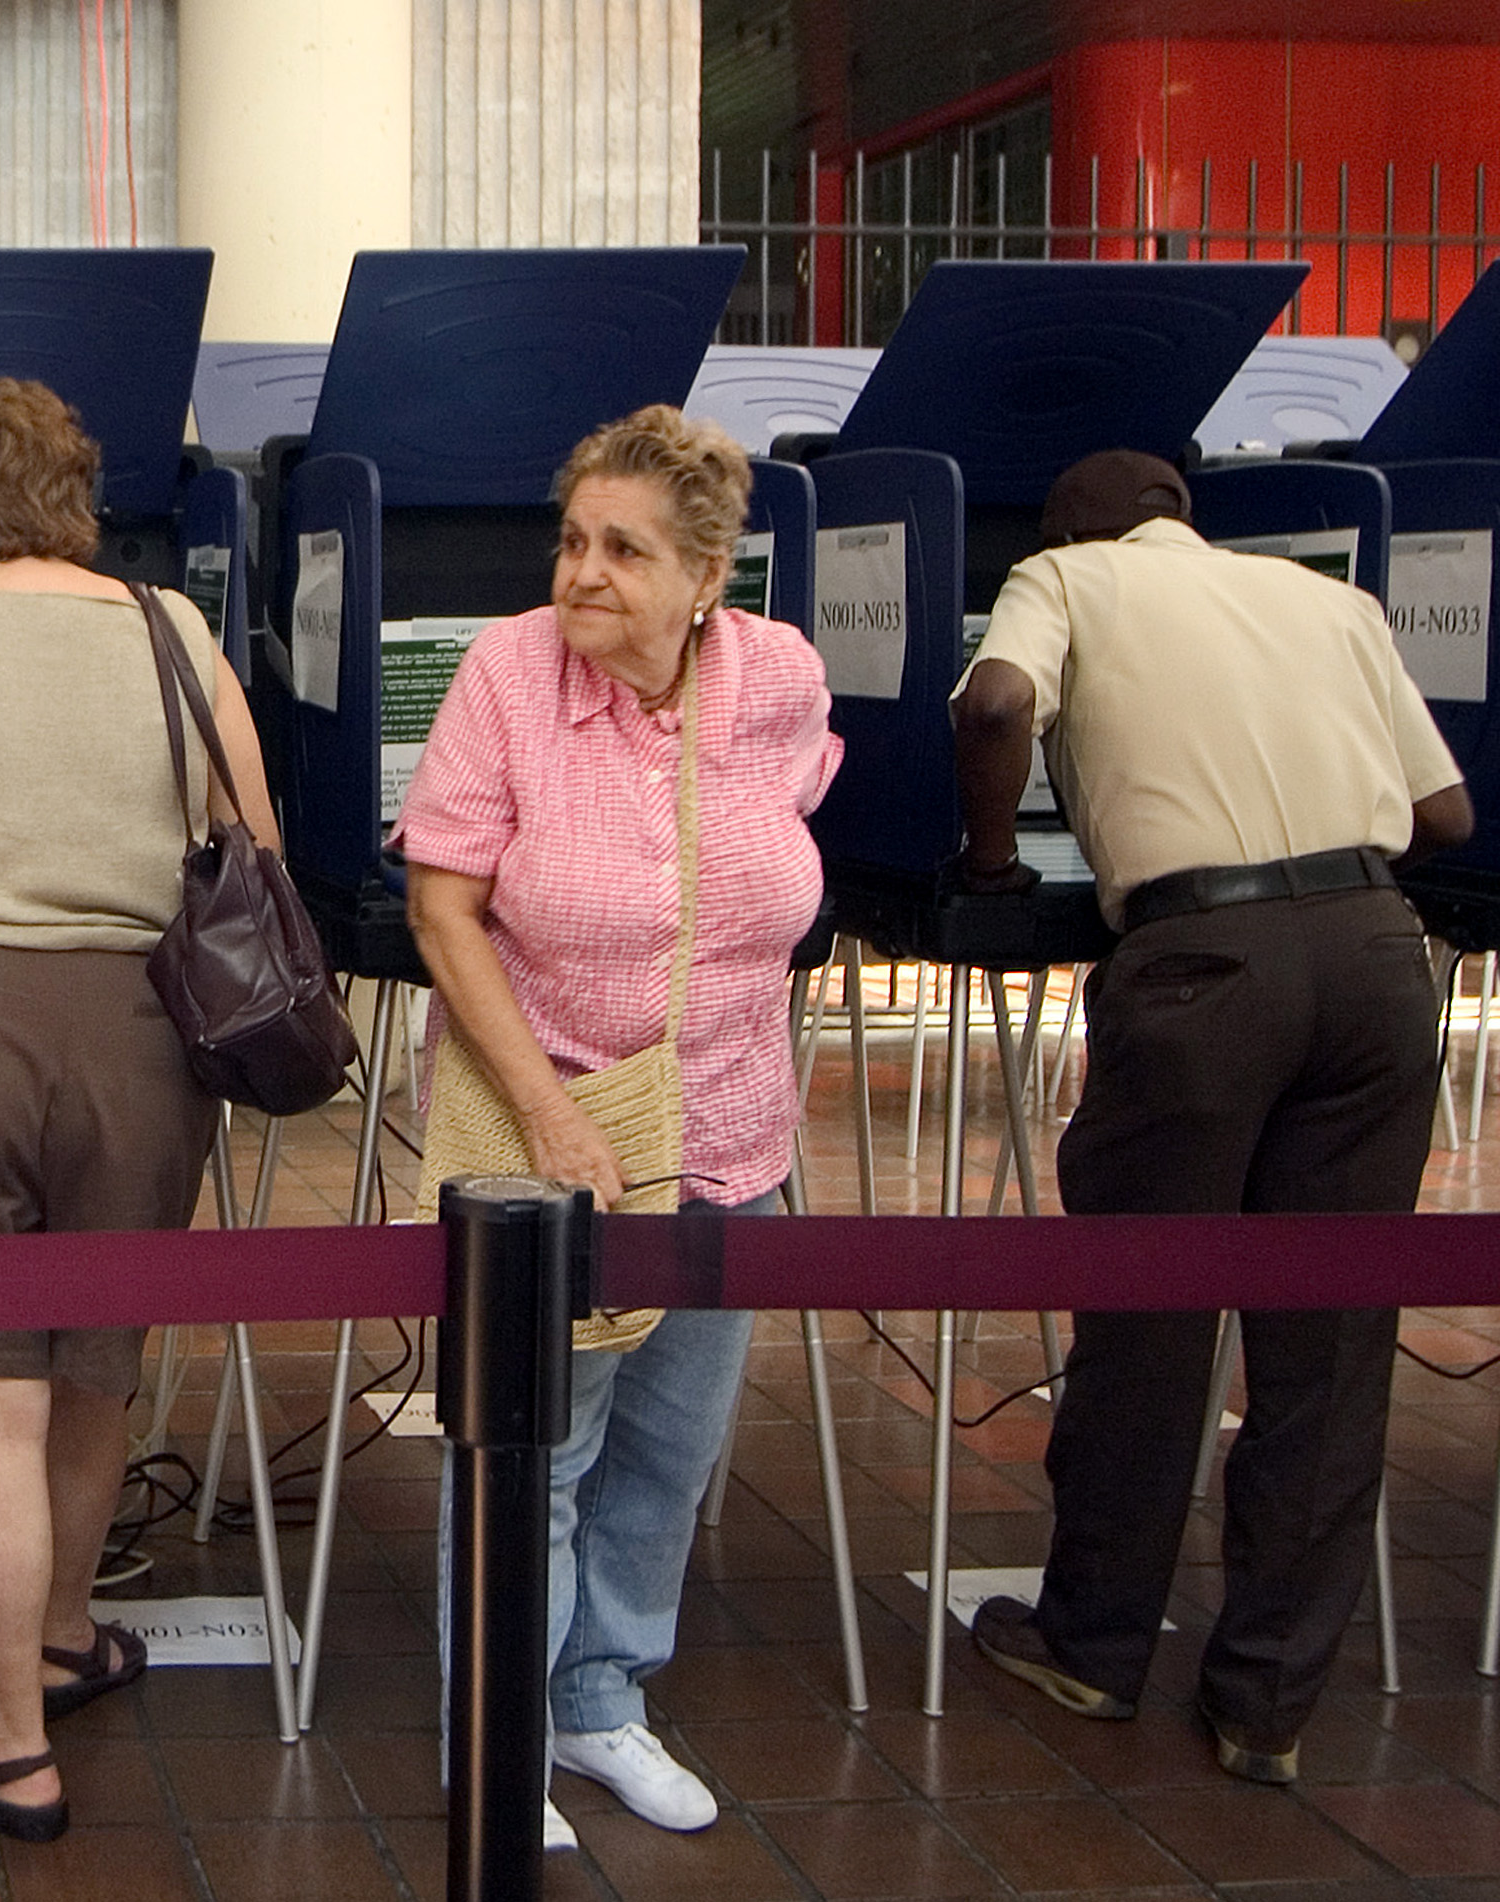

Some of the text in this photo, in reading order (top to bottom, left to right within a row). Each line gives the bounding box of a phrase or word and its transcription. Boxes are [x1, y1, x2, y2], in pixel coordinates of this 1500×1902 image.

[819, 601, 901, 632] N001-N033
[1388, 604, 1481, 636] 01-N033
[130, 1623, 264, 1639] 001-N03
